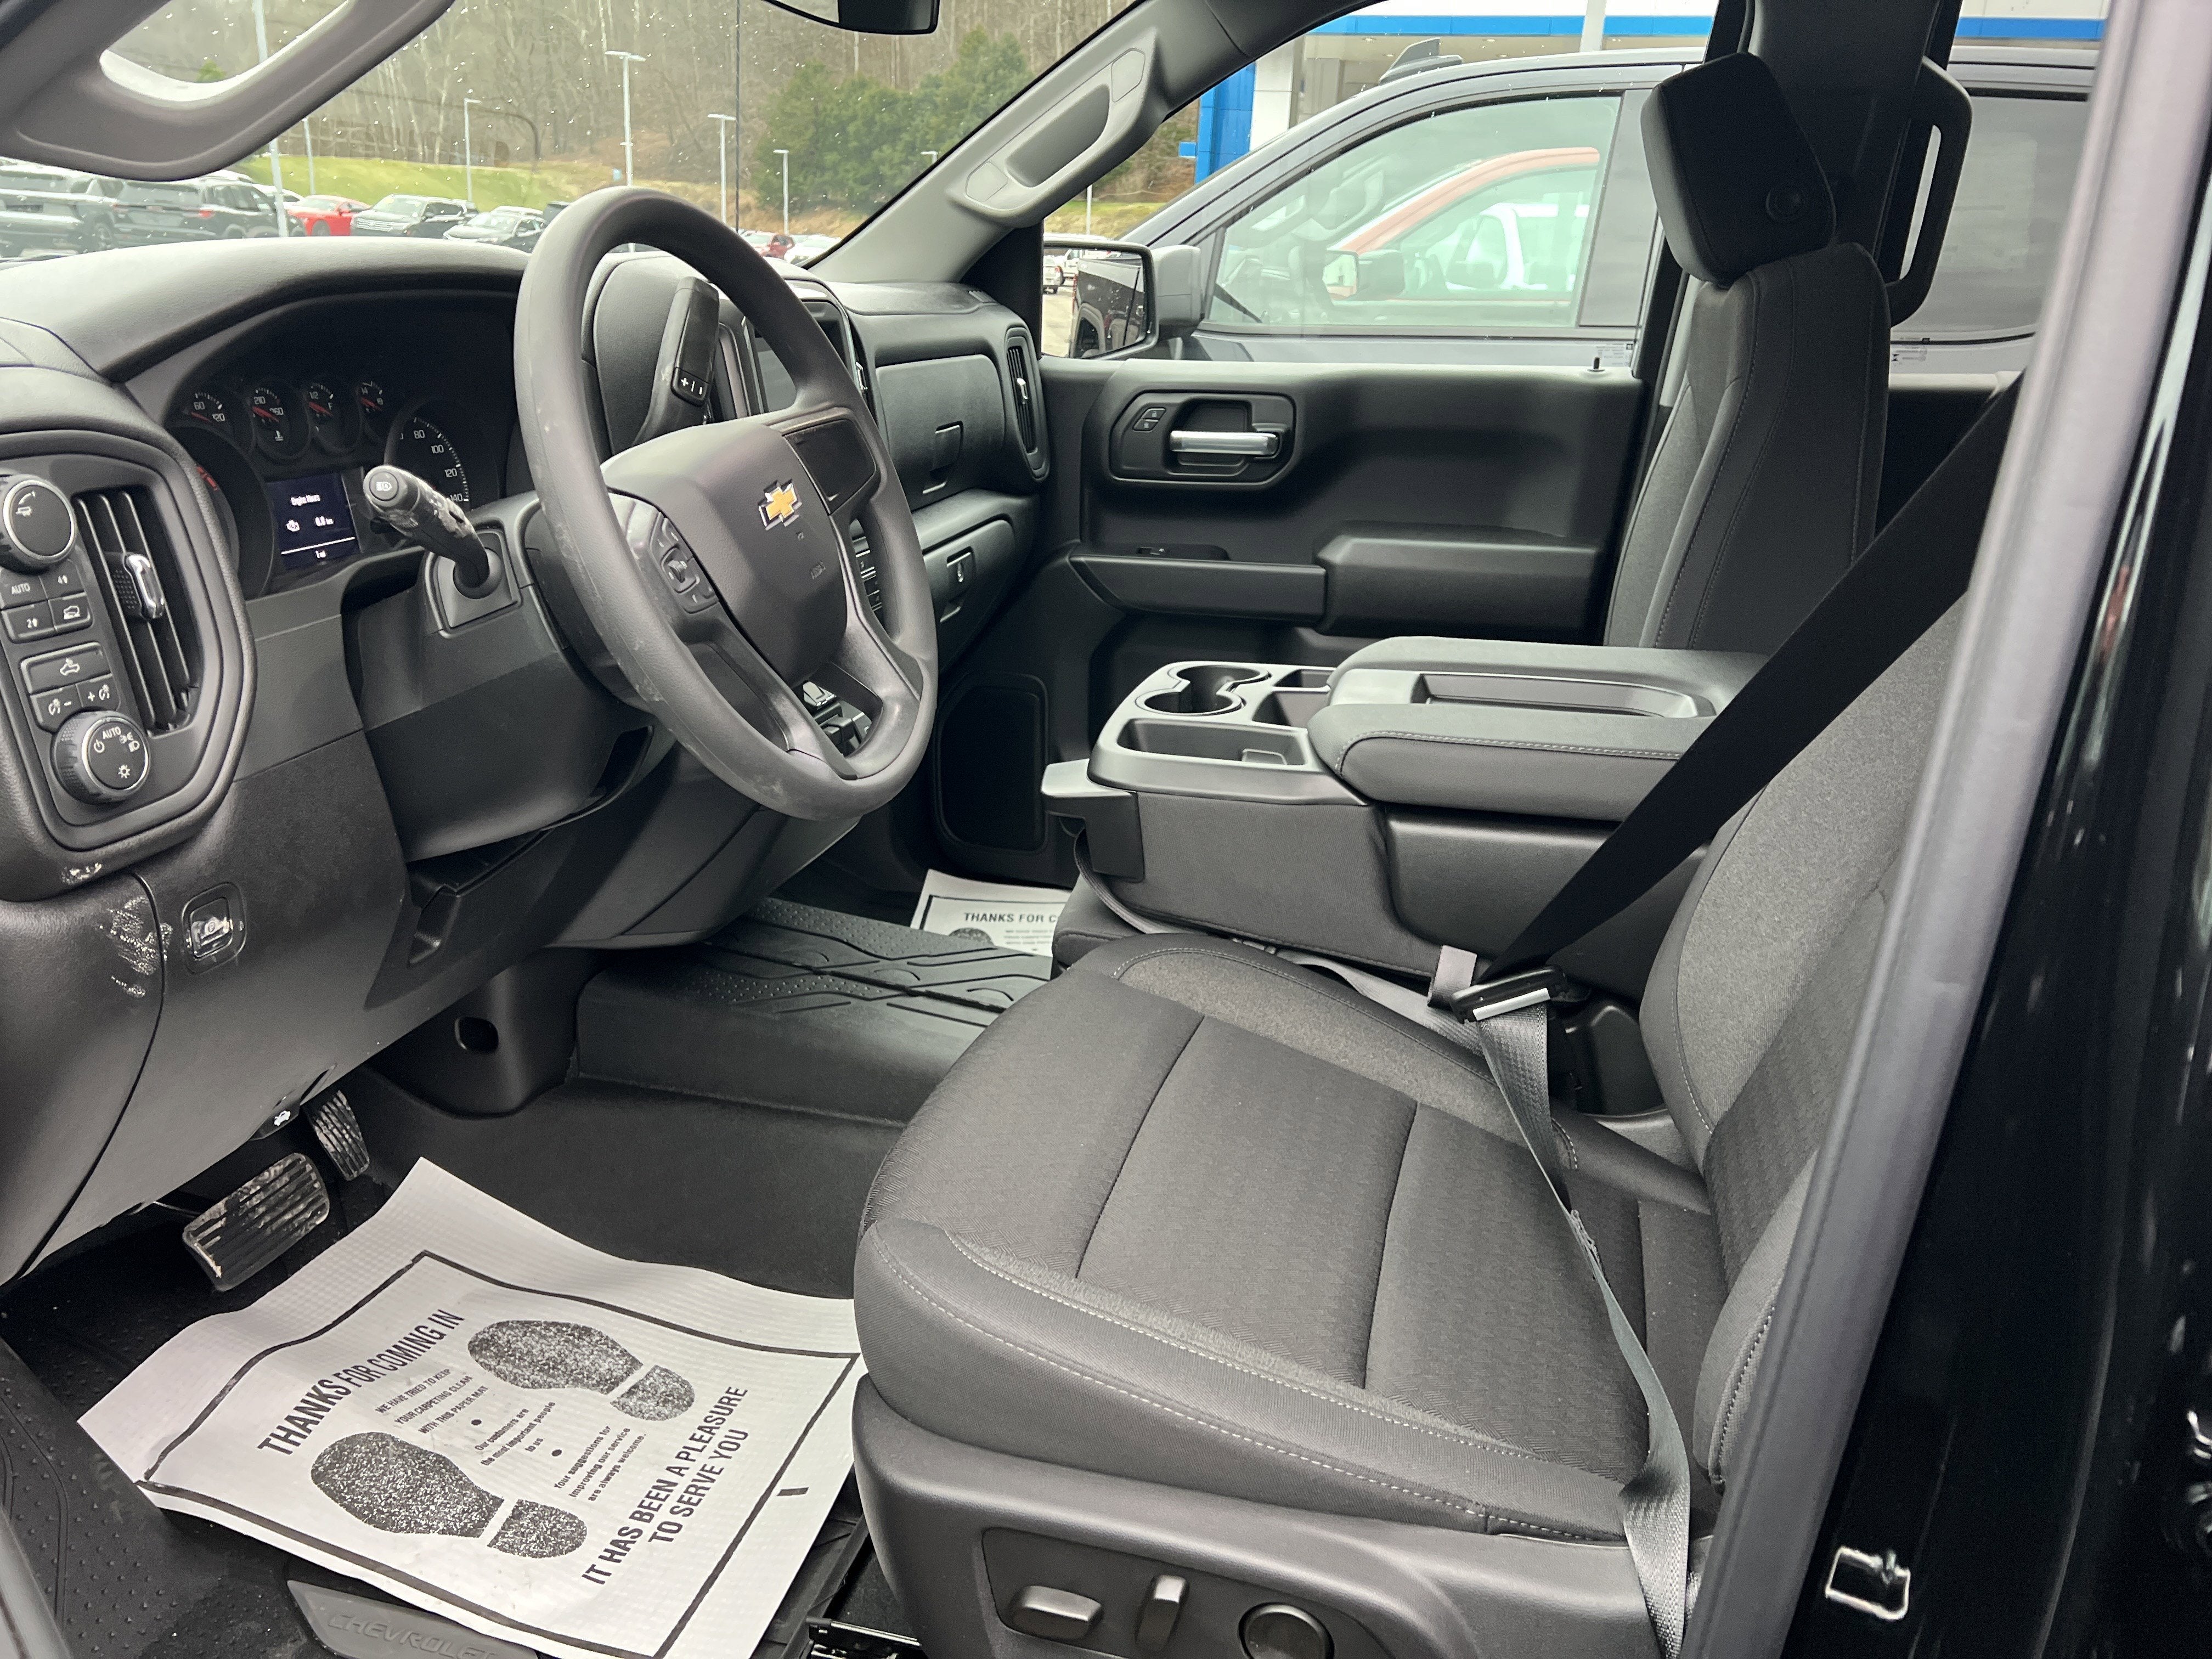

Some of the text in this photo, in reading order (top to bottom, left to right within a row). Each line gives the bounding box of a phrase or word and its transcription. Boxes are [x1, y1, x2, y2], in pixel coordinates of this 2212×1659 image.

[194, 402, 205, 410] 60
[414, 430, 425, 439] 80
[430, 444, 444, 454] 100
[444, 468, 458, 478] 120
[450, 493, 463, 502] 140
[11, 583, 31, 595] AUTO
[102, 726, 122, 740] AUTO
[964, 912, 1014, 923] THANKS
[1018, 913, 1044, 923] FOR
[256, 1309, 465, 1455] THANKS FOR COMING IN
[375, 1369, 451, 1413] WE HAVE TRIED TO KEEP
[394, 1375, 473, 1425] YOUR CARPETING CLEAN
[418, 1421, 439, 1434] WITH
[450, 1396, 475, 1414] PAPER
[471, 1385, 489, 1398] MAT
[475, 1442, 489, 1451] Our
[516, 1408, 529, 1418] are
[598, 1451, 611, 1463] our
[608, 1427, 631, 1451] service
[554, 1425, 611, 1489] Your suggestions for
[581, 1386, 748, 1585] IT HAS BEEN A PLEASURE
[588, 1489, 602, 1502] are
[599, 1464, 622, 1488] always
[648, 1429, 749, 1543] TO SERVE YOU
